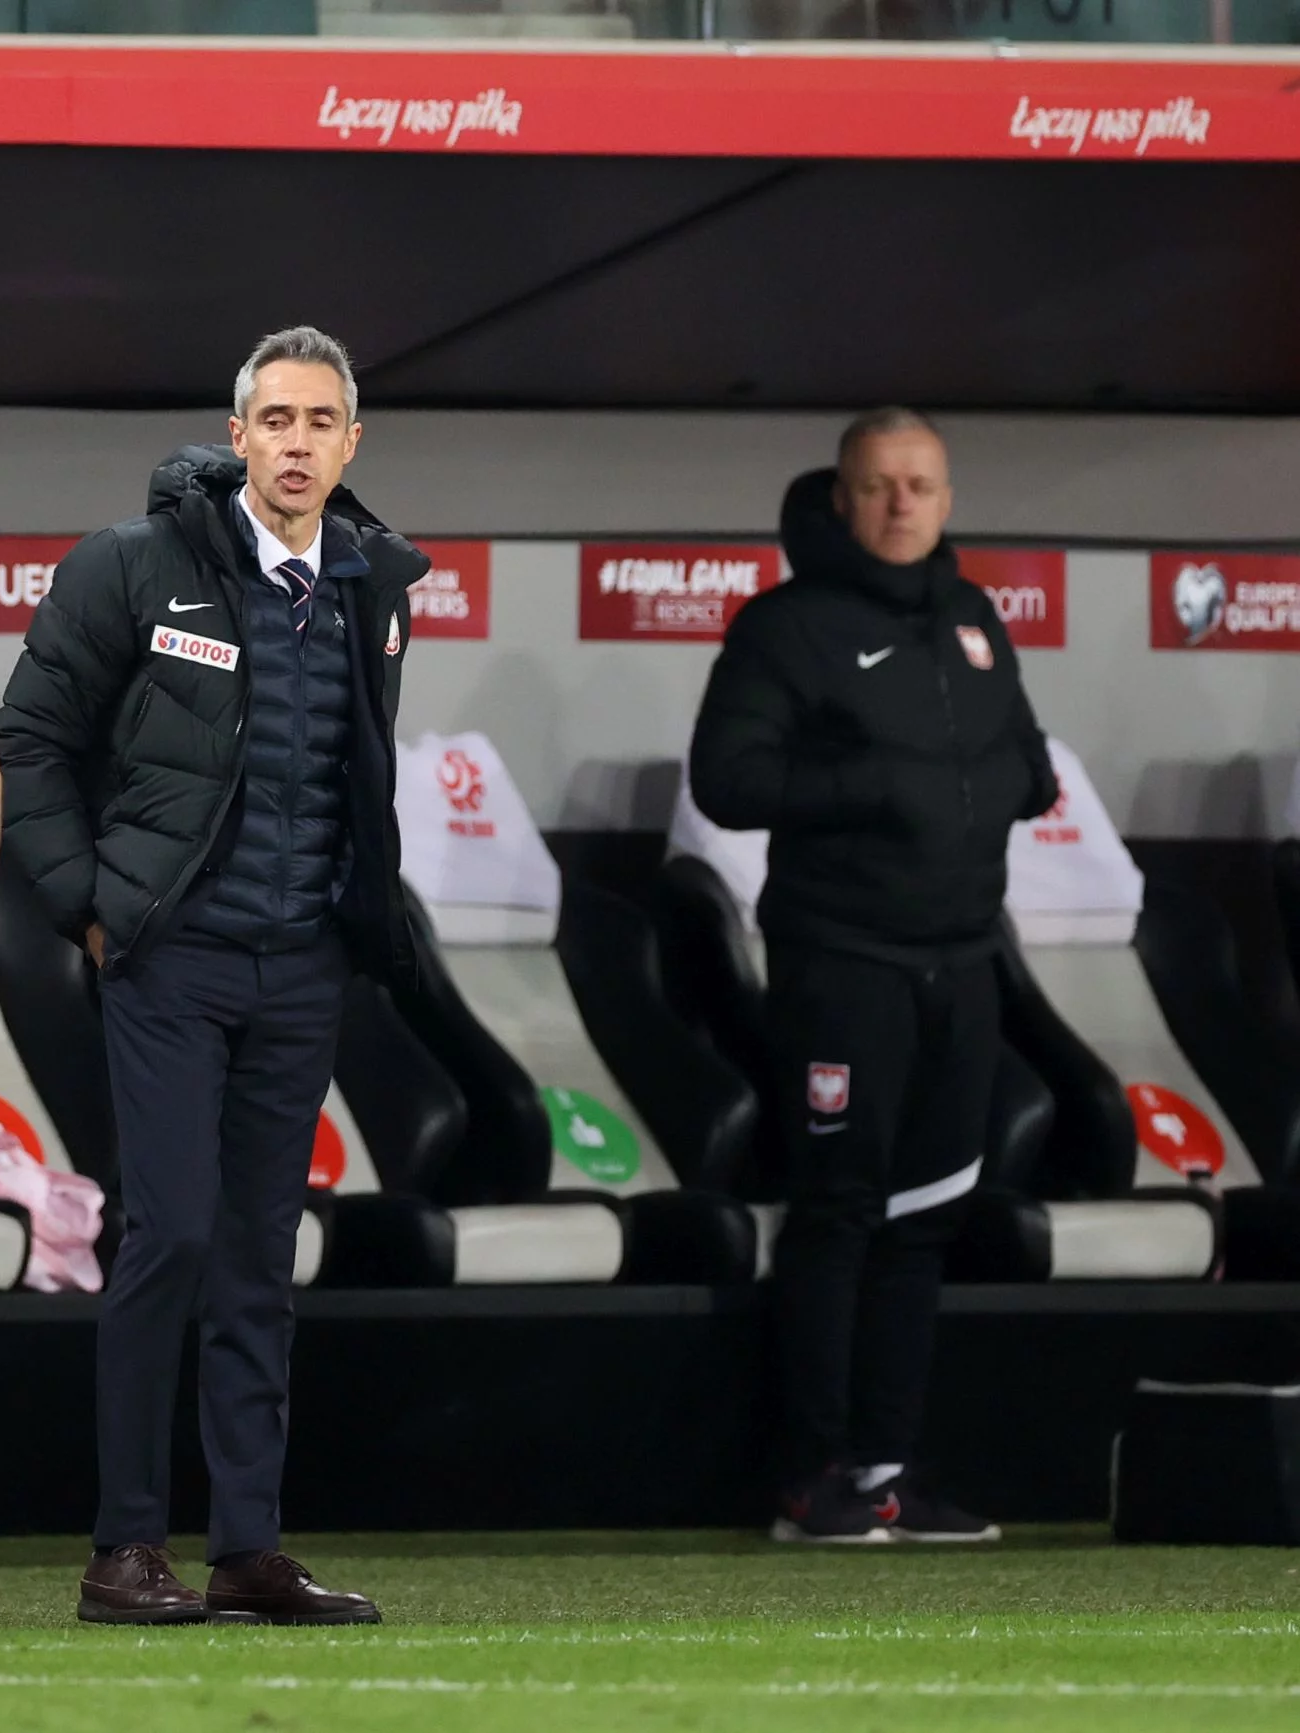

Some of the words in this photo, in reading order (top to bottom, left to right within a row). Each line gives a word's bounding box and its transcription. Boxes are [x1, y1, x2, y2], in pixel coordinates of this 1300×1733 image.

[317, 85, 401, 146] Łączy
[401, 99, 454, 134] nas
[445, 87, 522, 147] piłka
[1010, 96, 1092, 156] Łączy
[1092, 108, 1143, 143] nas
[1135, 96, 1210, 157] piłka
[180, 637, 232, 664] LOTOS
